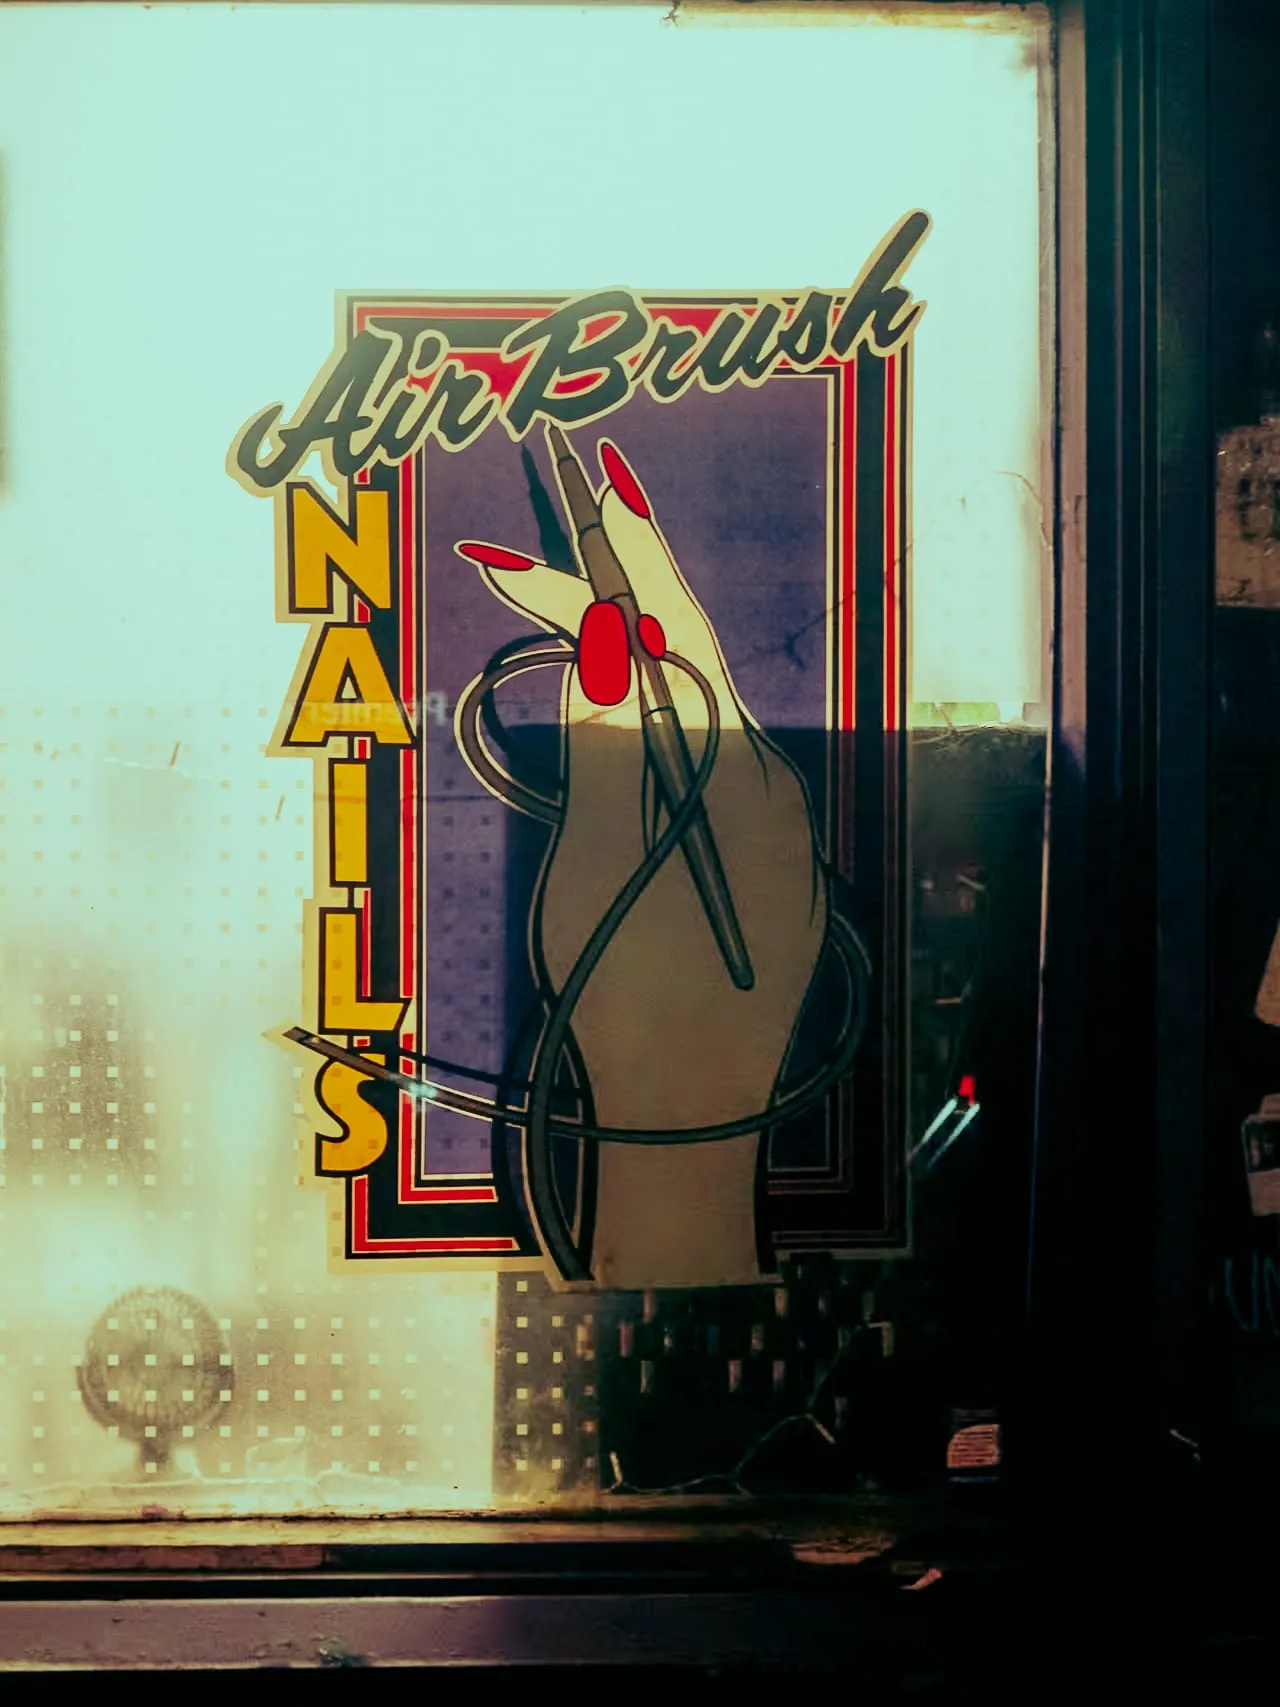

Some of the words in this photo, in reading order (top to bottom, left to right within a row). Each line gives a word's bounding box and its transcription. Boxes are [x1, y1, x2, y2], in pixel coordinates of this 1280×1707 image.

[236, 326, 495, 487] Air
[506, 211, 930, 441] Brush
[282, 482, 417, 1177] NAILS
